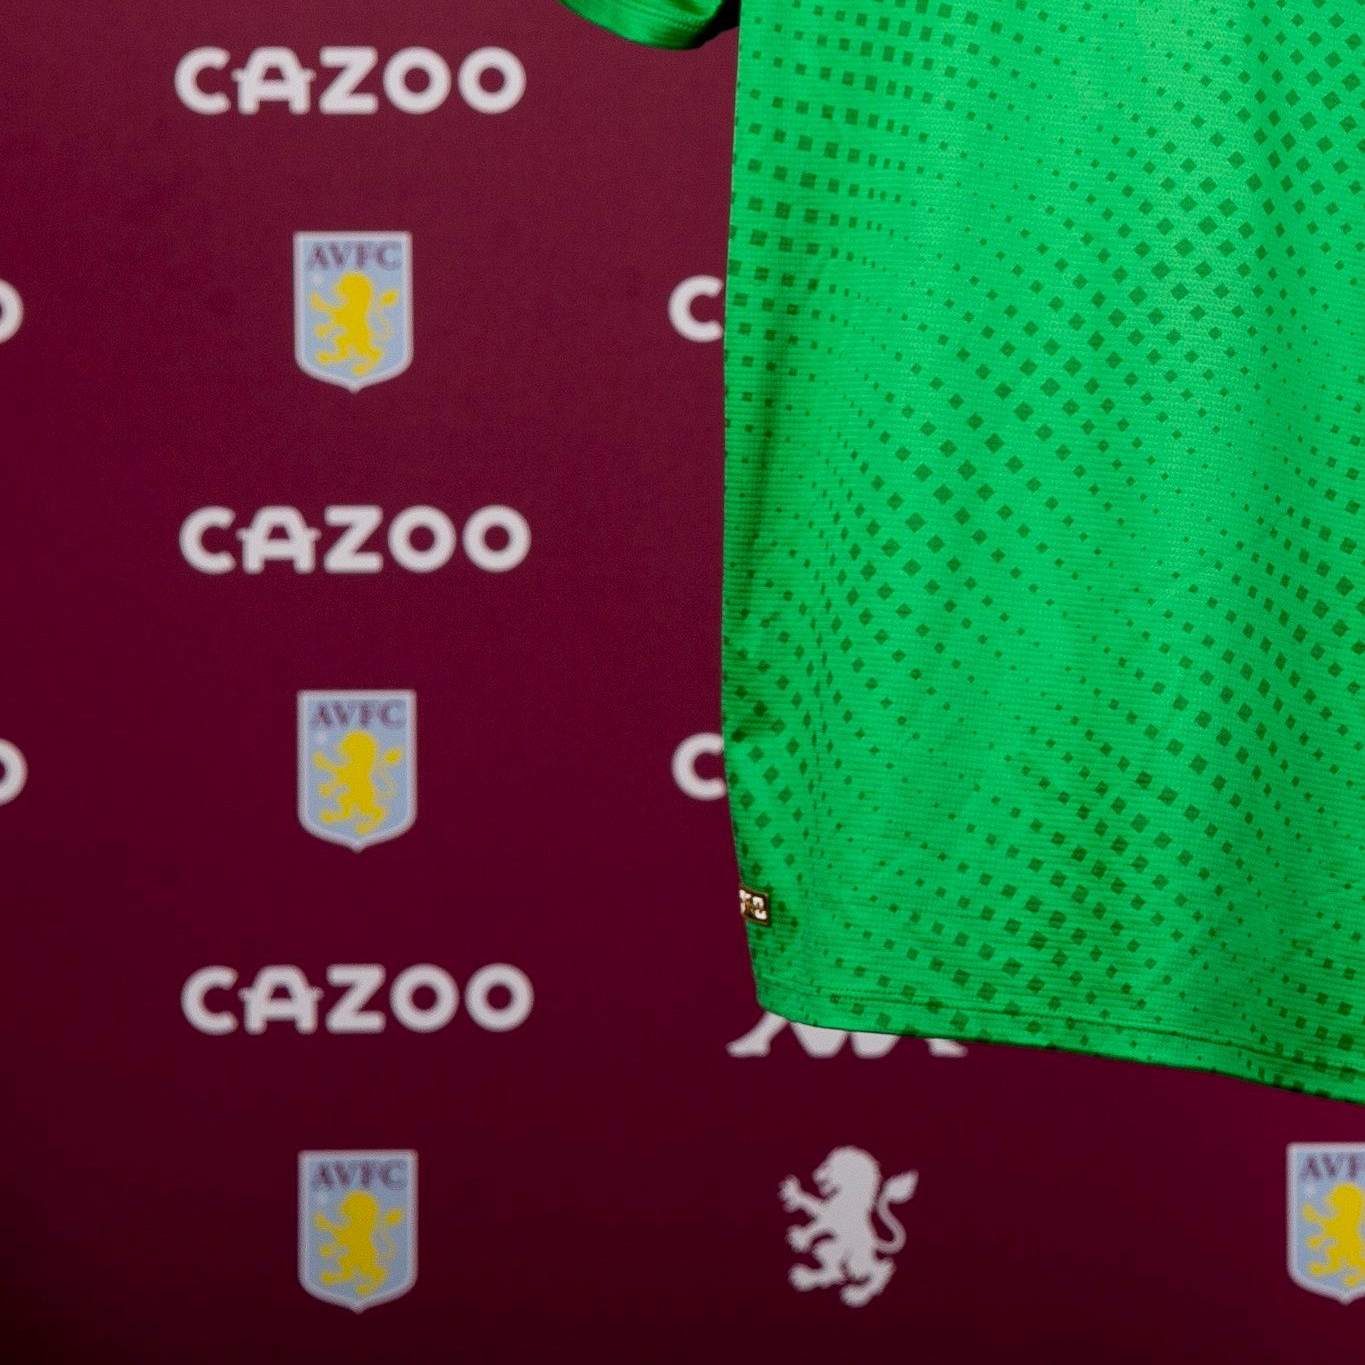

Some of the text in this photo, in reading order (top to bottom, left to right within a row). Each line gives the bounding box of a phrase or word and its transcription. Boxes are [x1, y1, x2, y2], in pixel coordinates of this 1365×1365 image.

[175, 46, 525, 114] CAZOO
[307, 240, 402, 270] AVFC
[180, 505, 530, 573] CAZOO
[310, 699, 406, 729] AVFC
[183, 965, 531, 1032] CAZOO
[313, 1159, 408, 1189] AVFC
